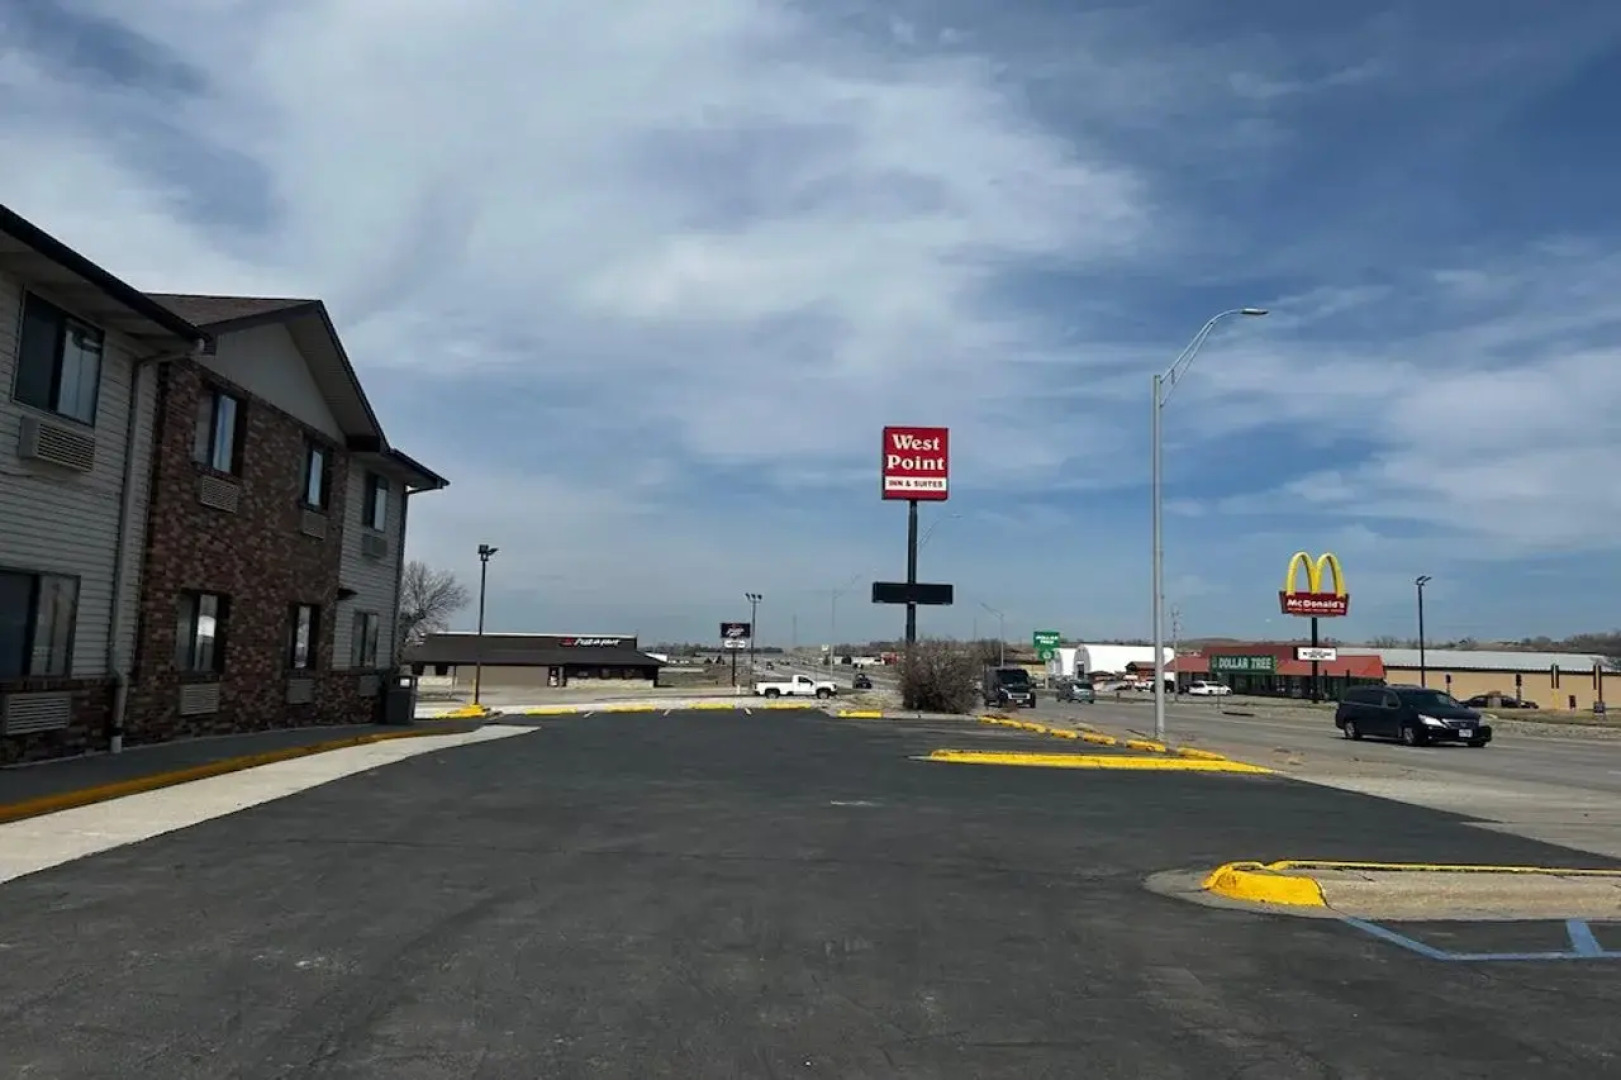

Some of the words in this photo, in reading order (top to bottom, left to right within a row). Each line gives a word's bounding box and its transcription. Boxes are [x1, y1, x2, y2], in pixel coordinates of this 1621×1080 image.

[892, 434, 940, 451] West
[887, 454, 945, 470] Point
[914, 480, 943, 488] SUITES
[1287, 599, 1345, 609] McDonald's
[1218, 657, 1248, 669] DOLLAR
[1250, 657, 1272, 670] TREE
